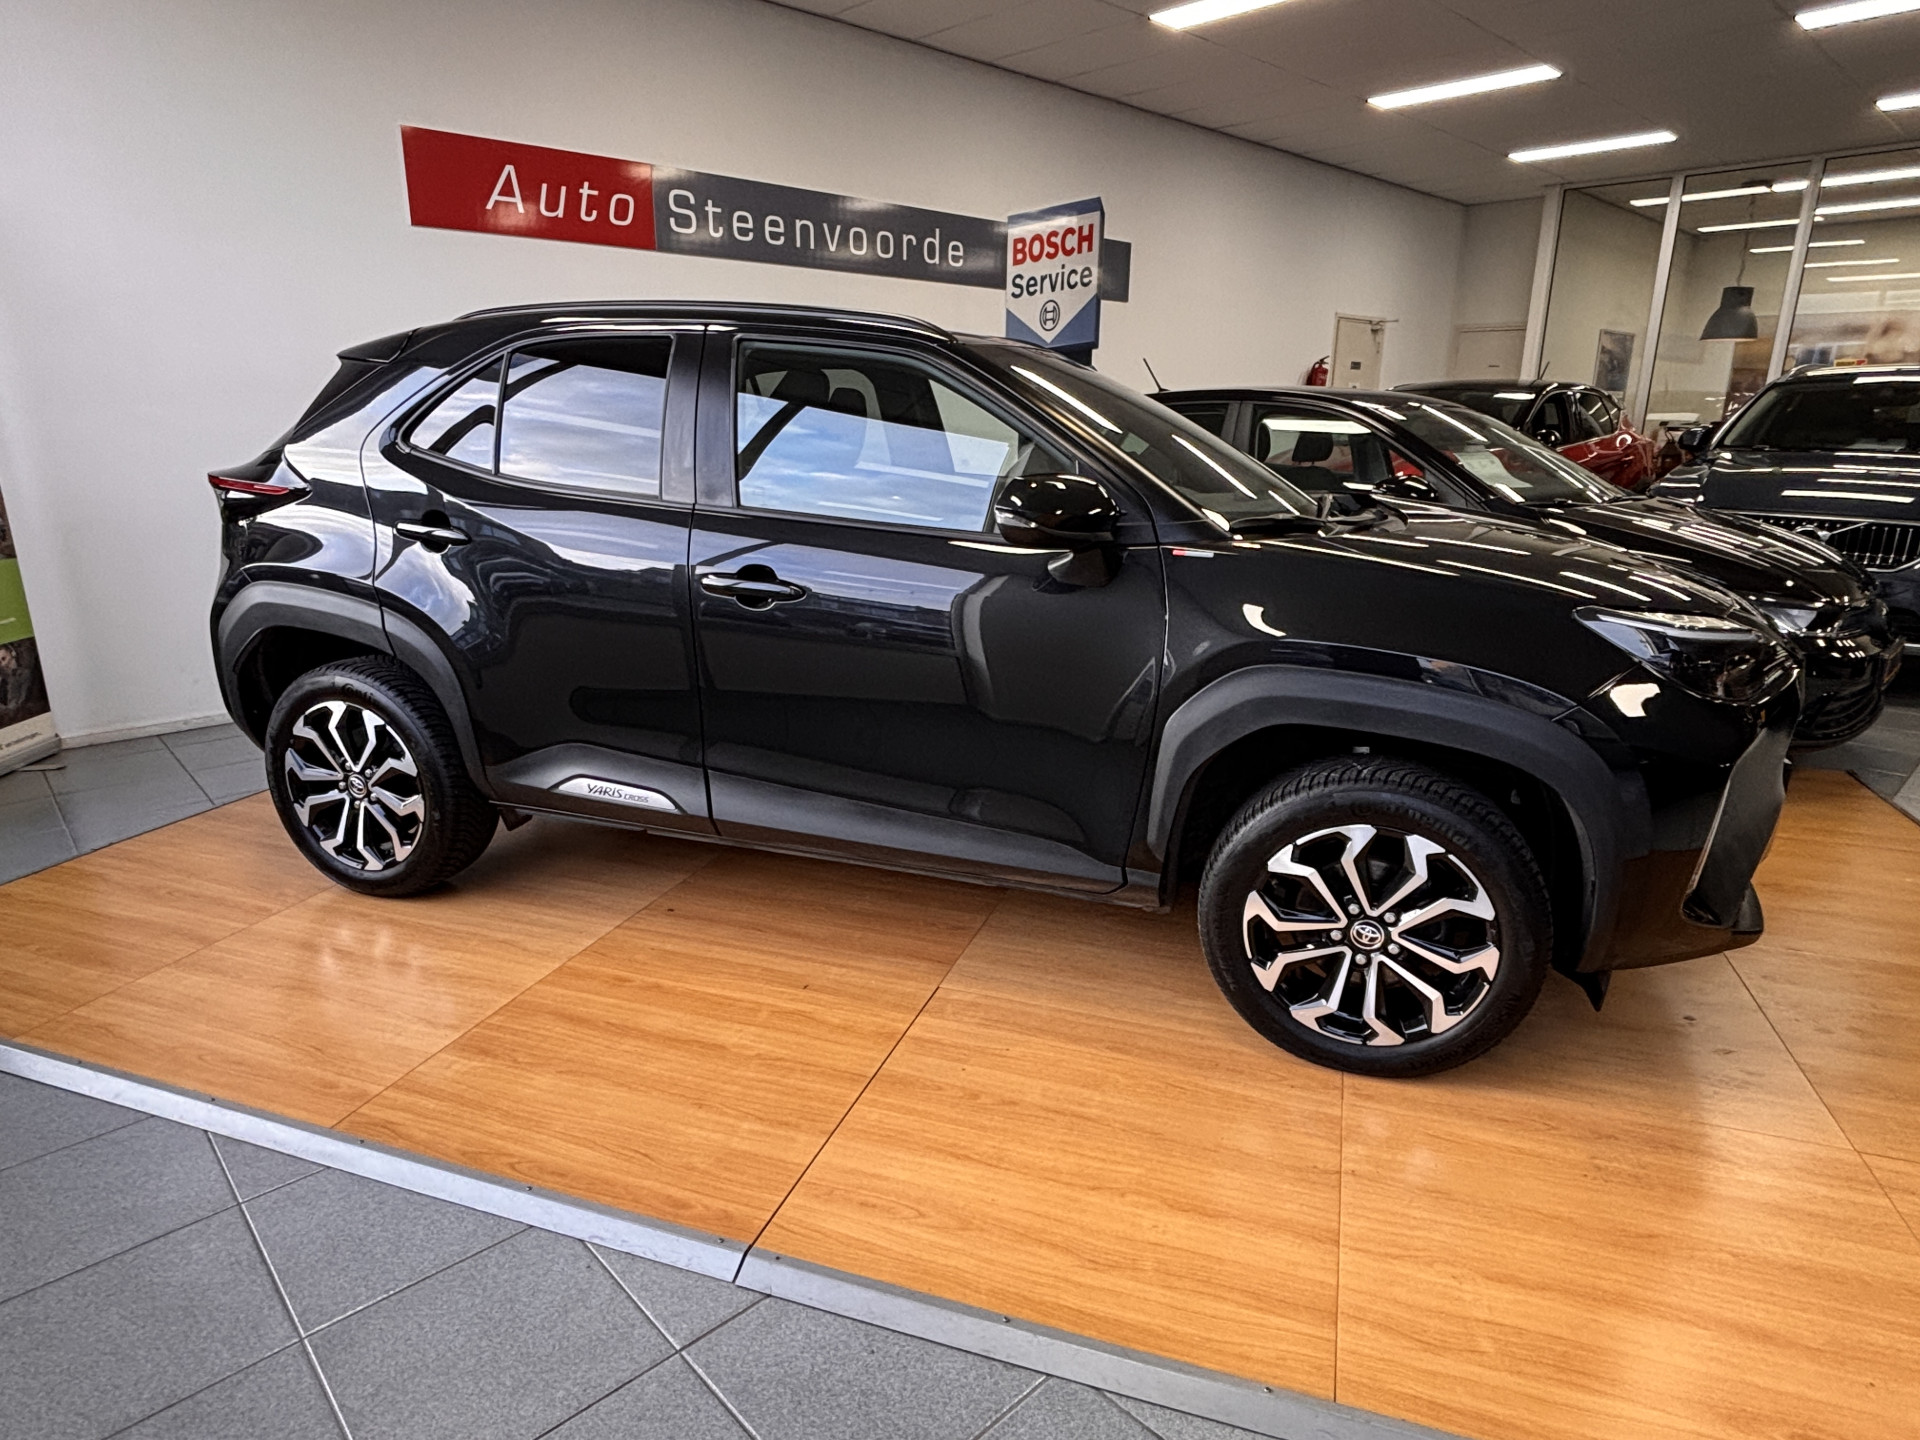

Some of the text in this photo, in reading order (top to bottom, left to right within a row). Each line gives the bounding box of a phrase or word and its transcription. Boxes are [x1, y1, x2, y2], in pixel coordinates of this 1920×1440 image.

[485, 164, 964, 268] Auto Steenvoorde
[1012, 223, 1094, 267] BOSCH
[1011, 264, 1093, 299] Service
[623, 793, 650, 804] CROSS
